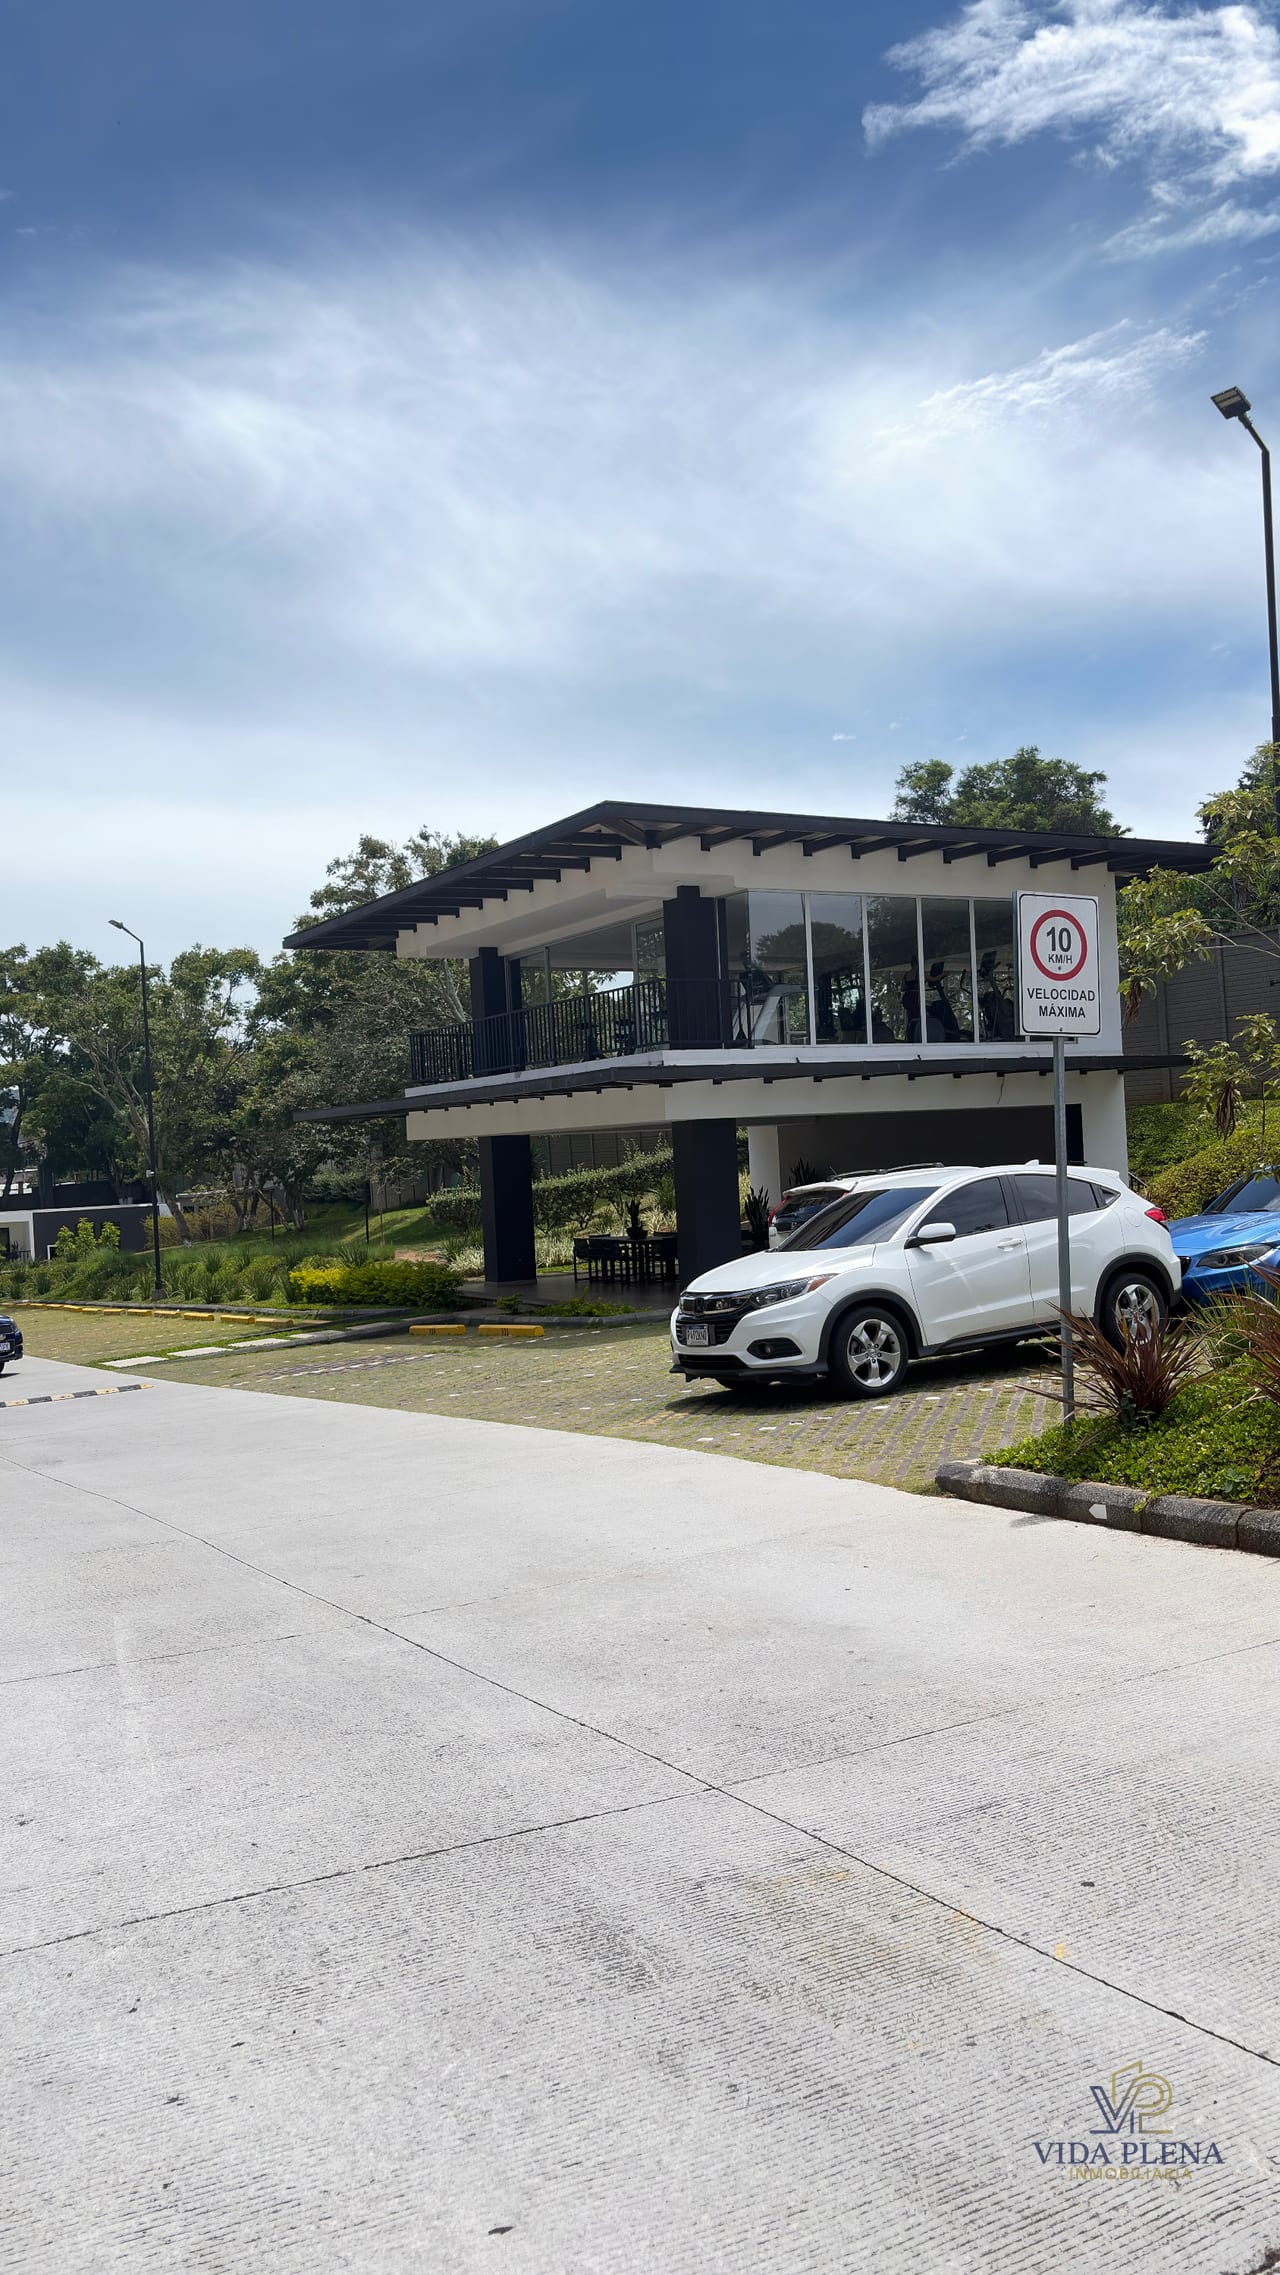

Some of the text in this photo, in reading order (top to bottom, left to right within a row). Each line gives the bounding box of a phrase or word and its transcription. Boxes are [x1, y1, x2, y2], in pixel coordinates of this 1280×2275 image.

[1046, 926, 1072, 953] 10
[1048, 953, 1073, 965] KM/H
[1027, 988, 1096, 1002] VELOCIDAD
[1039, 1002, 1086, 1018] MÁXIMA
